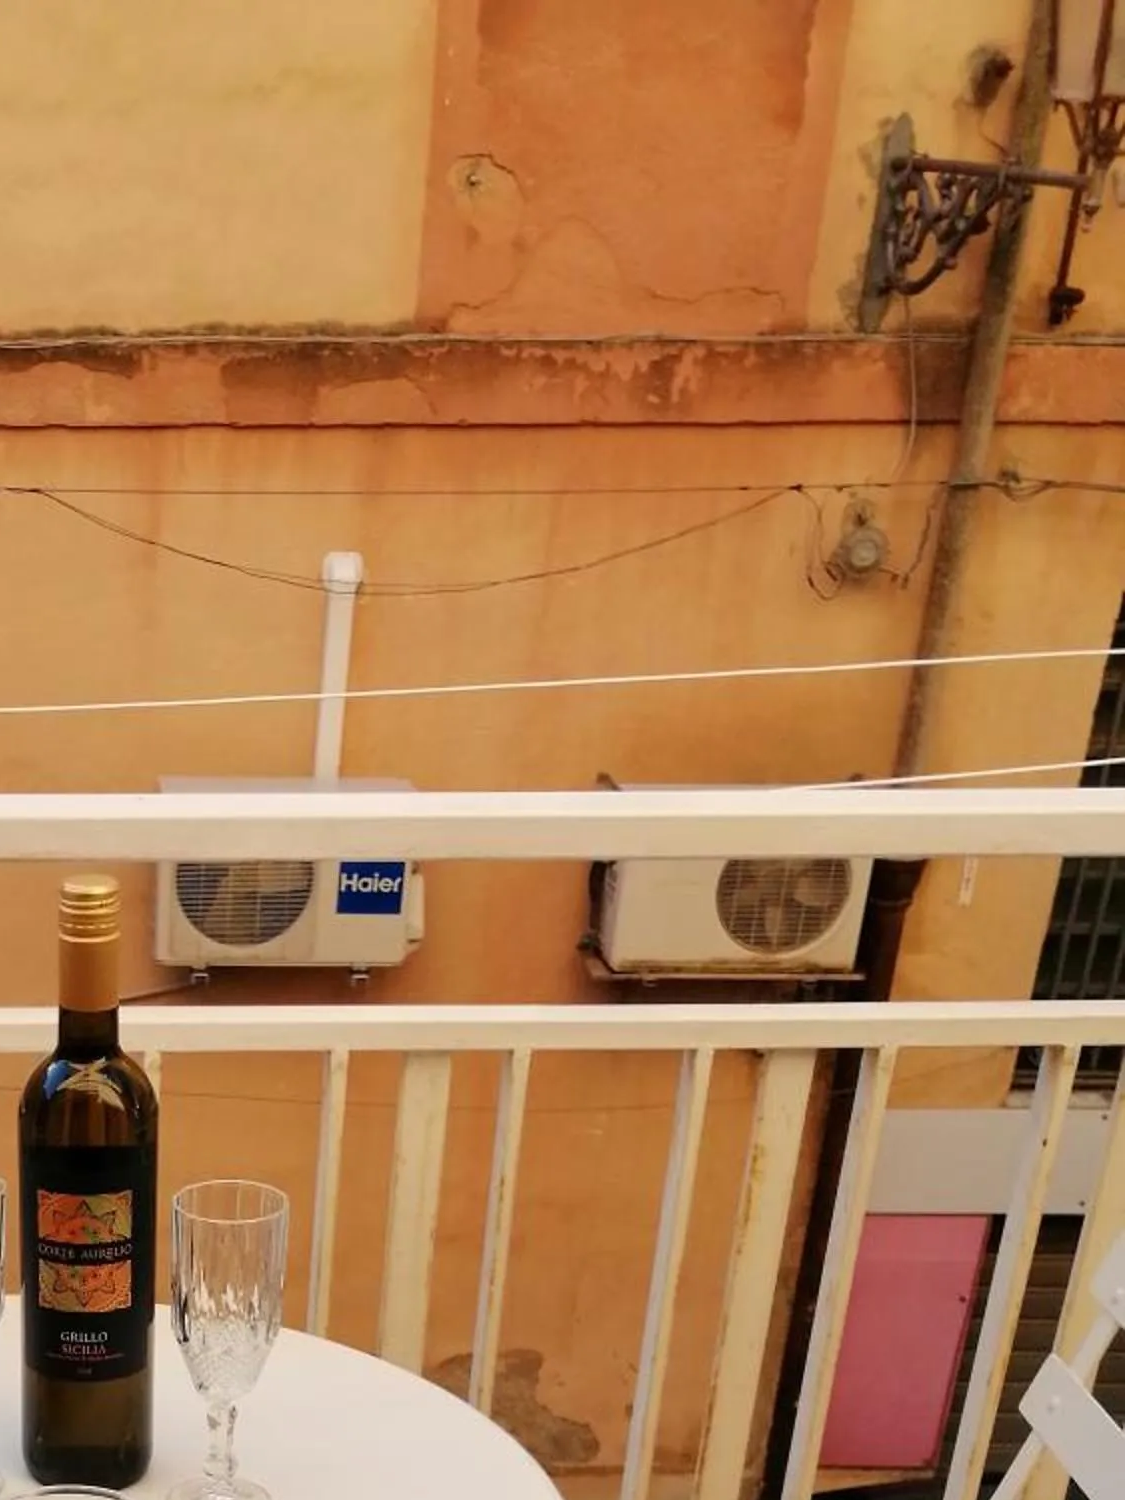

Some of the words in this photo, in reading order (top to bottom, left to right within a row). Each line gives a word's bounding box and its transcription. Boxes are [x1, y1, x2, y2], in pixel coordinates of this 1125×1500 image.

[340, 872, 402, 893] Haier
[60, 1331, 108, 1343] GRILLO
[62, 1343, 106, 1355] SICILIA
